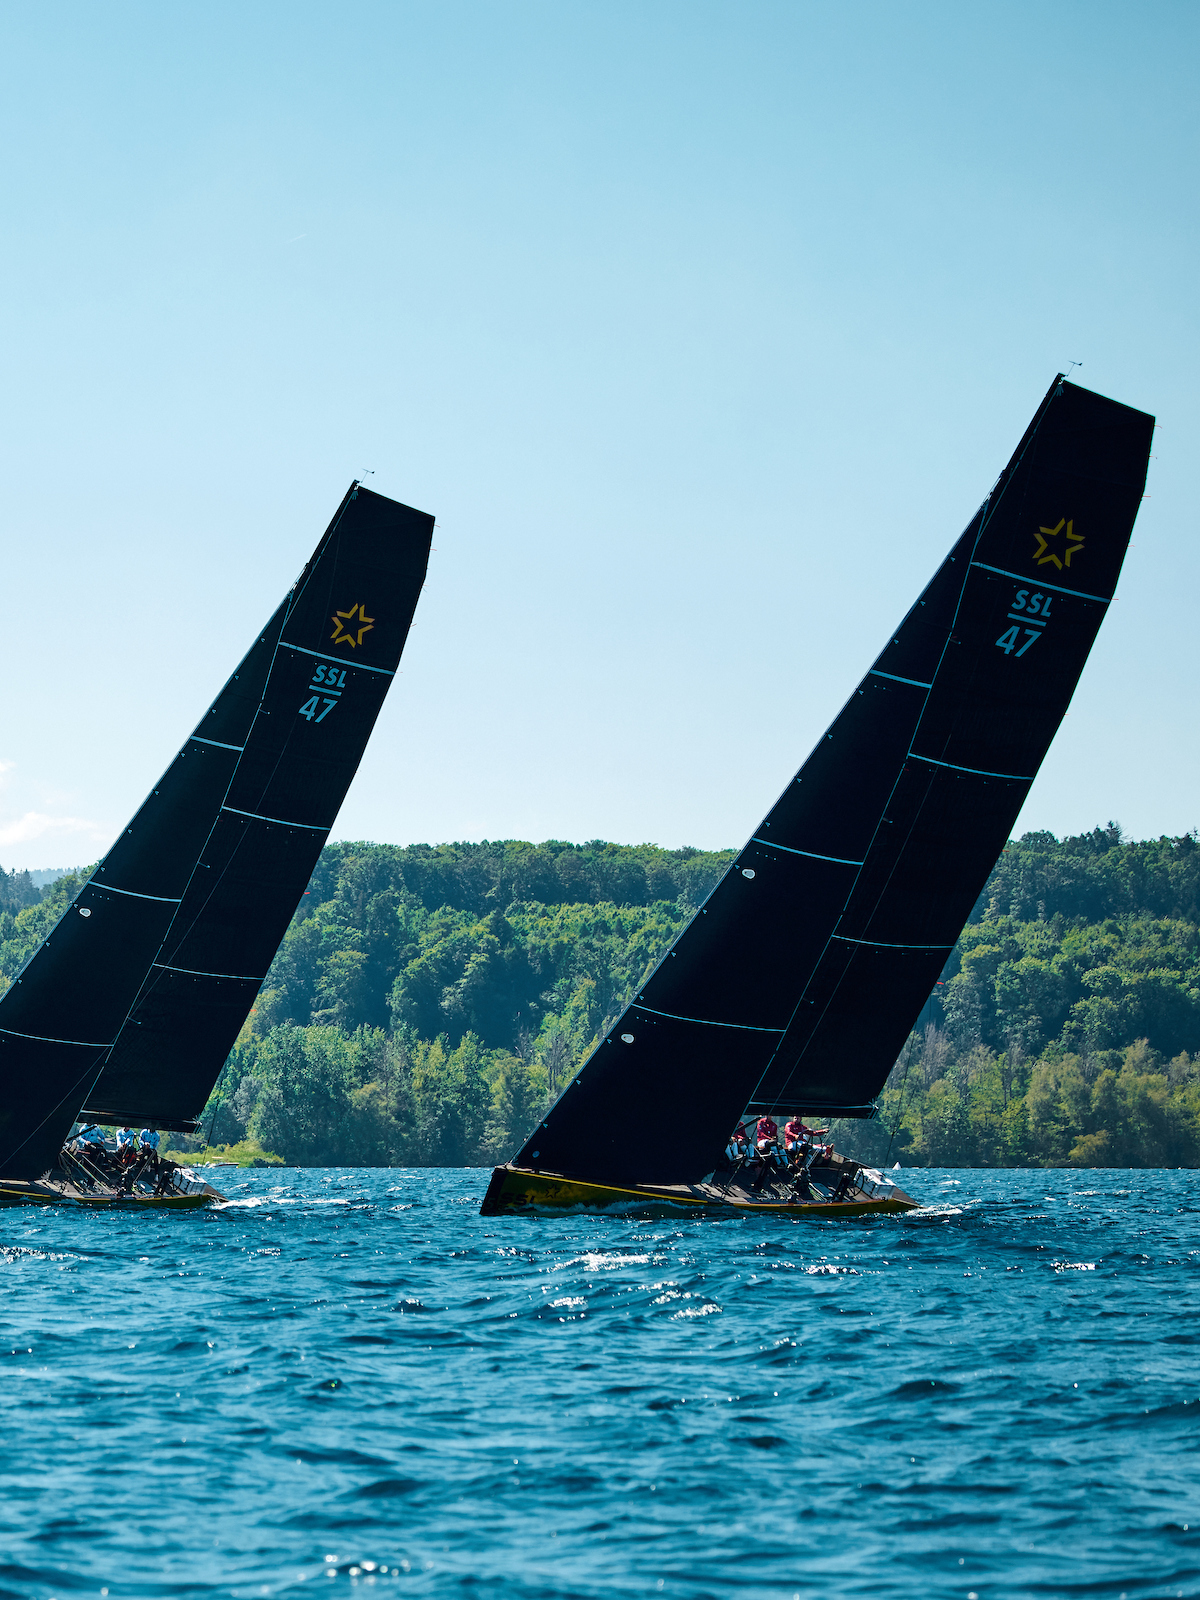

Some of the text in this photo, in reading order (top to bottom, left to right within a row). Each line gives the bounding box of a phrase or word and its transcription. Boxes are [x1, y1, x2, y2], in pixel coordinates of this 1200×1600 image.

[1011, 590, 1052, 617] SSL
[995, 625, 1042, 657] 47
[312, 665, 347, 688] SSL
[298, 696, 338, 723] 47
